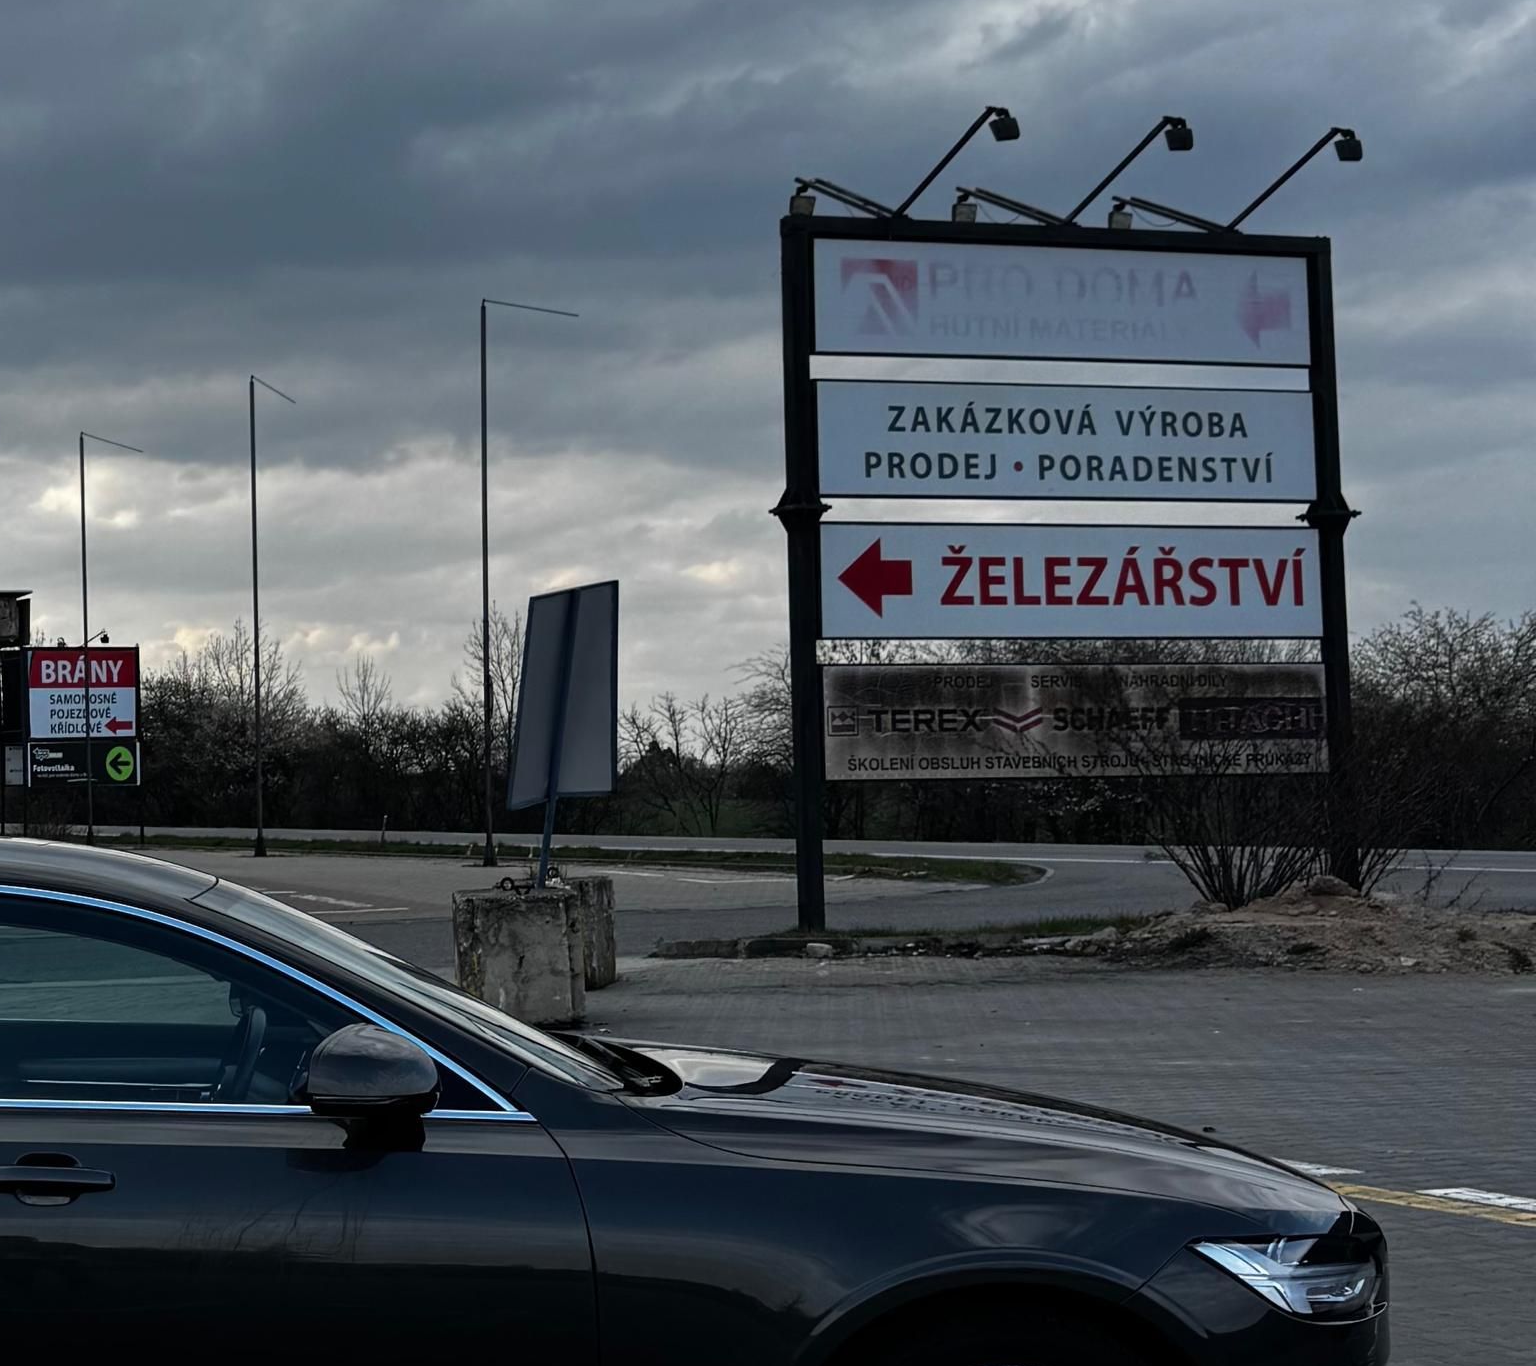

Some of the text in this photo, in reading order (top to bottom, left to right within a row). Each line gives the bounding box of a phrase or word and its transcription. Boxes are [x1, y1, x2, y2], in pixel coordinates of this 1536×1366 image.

[887, 401, 1248, 438] ZAKÁZKOVÁ VÝROBA
[865, 452, 1274, 484] PRODEJ PORADENSTVÍ
[940, 546, 1307, 607] ŽELEZÁŘSTVÍ
[41, 655, 123, 684] BRÁNY
[935, 674, 993, 688] PRODEJ
[1031, 675, 1082, 688] SERVIS
[49, 692, 117, 705] SAMONOSNÉ
[50, 707, 111, 719] POJEZDOVÉ
[867, 708, 985, 733] TEREX
[1052, 706, 1173, 731] SCHAEFF
[50, 721, 102, 734] KŘÍDLOVÉ
[848, 754, 914, 772] ŠKOLENÍ
[918, 756, 981, 770] OBSLUH
[985, 753, 1077, 769] STAVEBNÍCH
